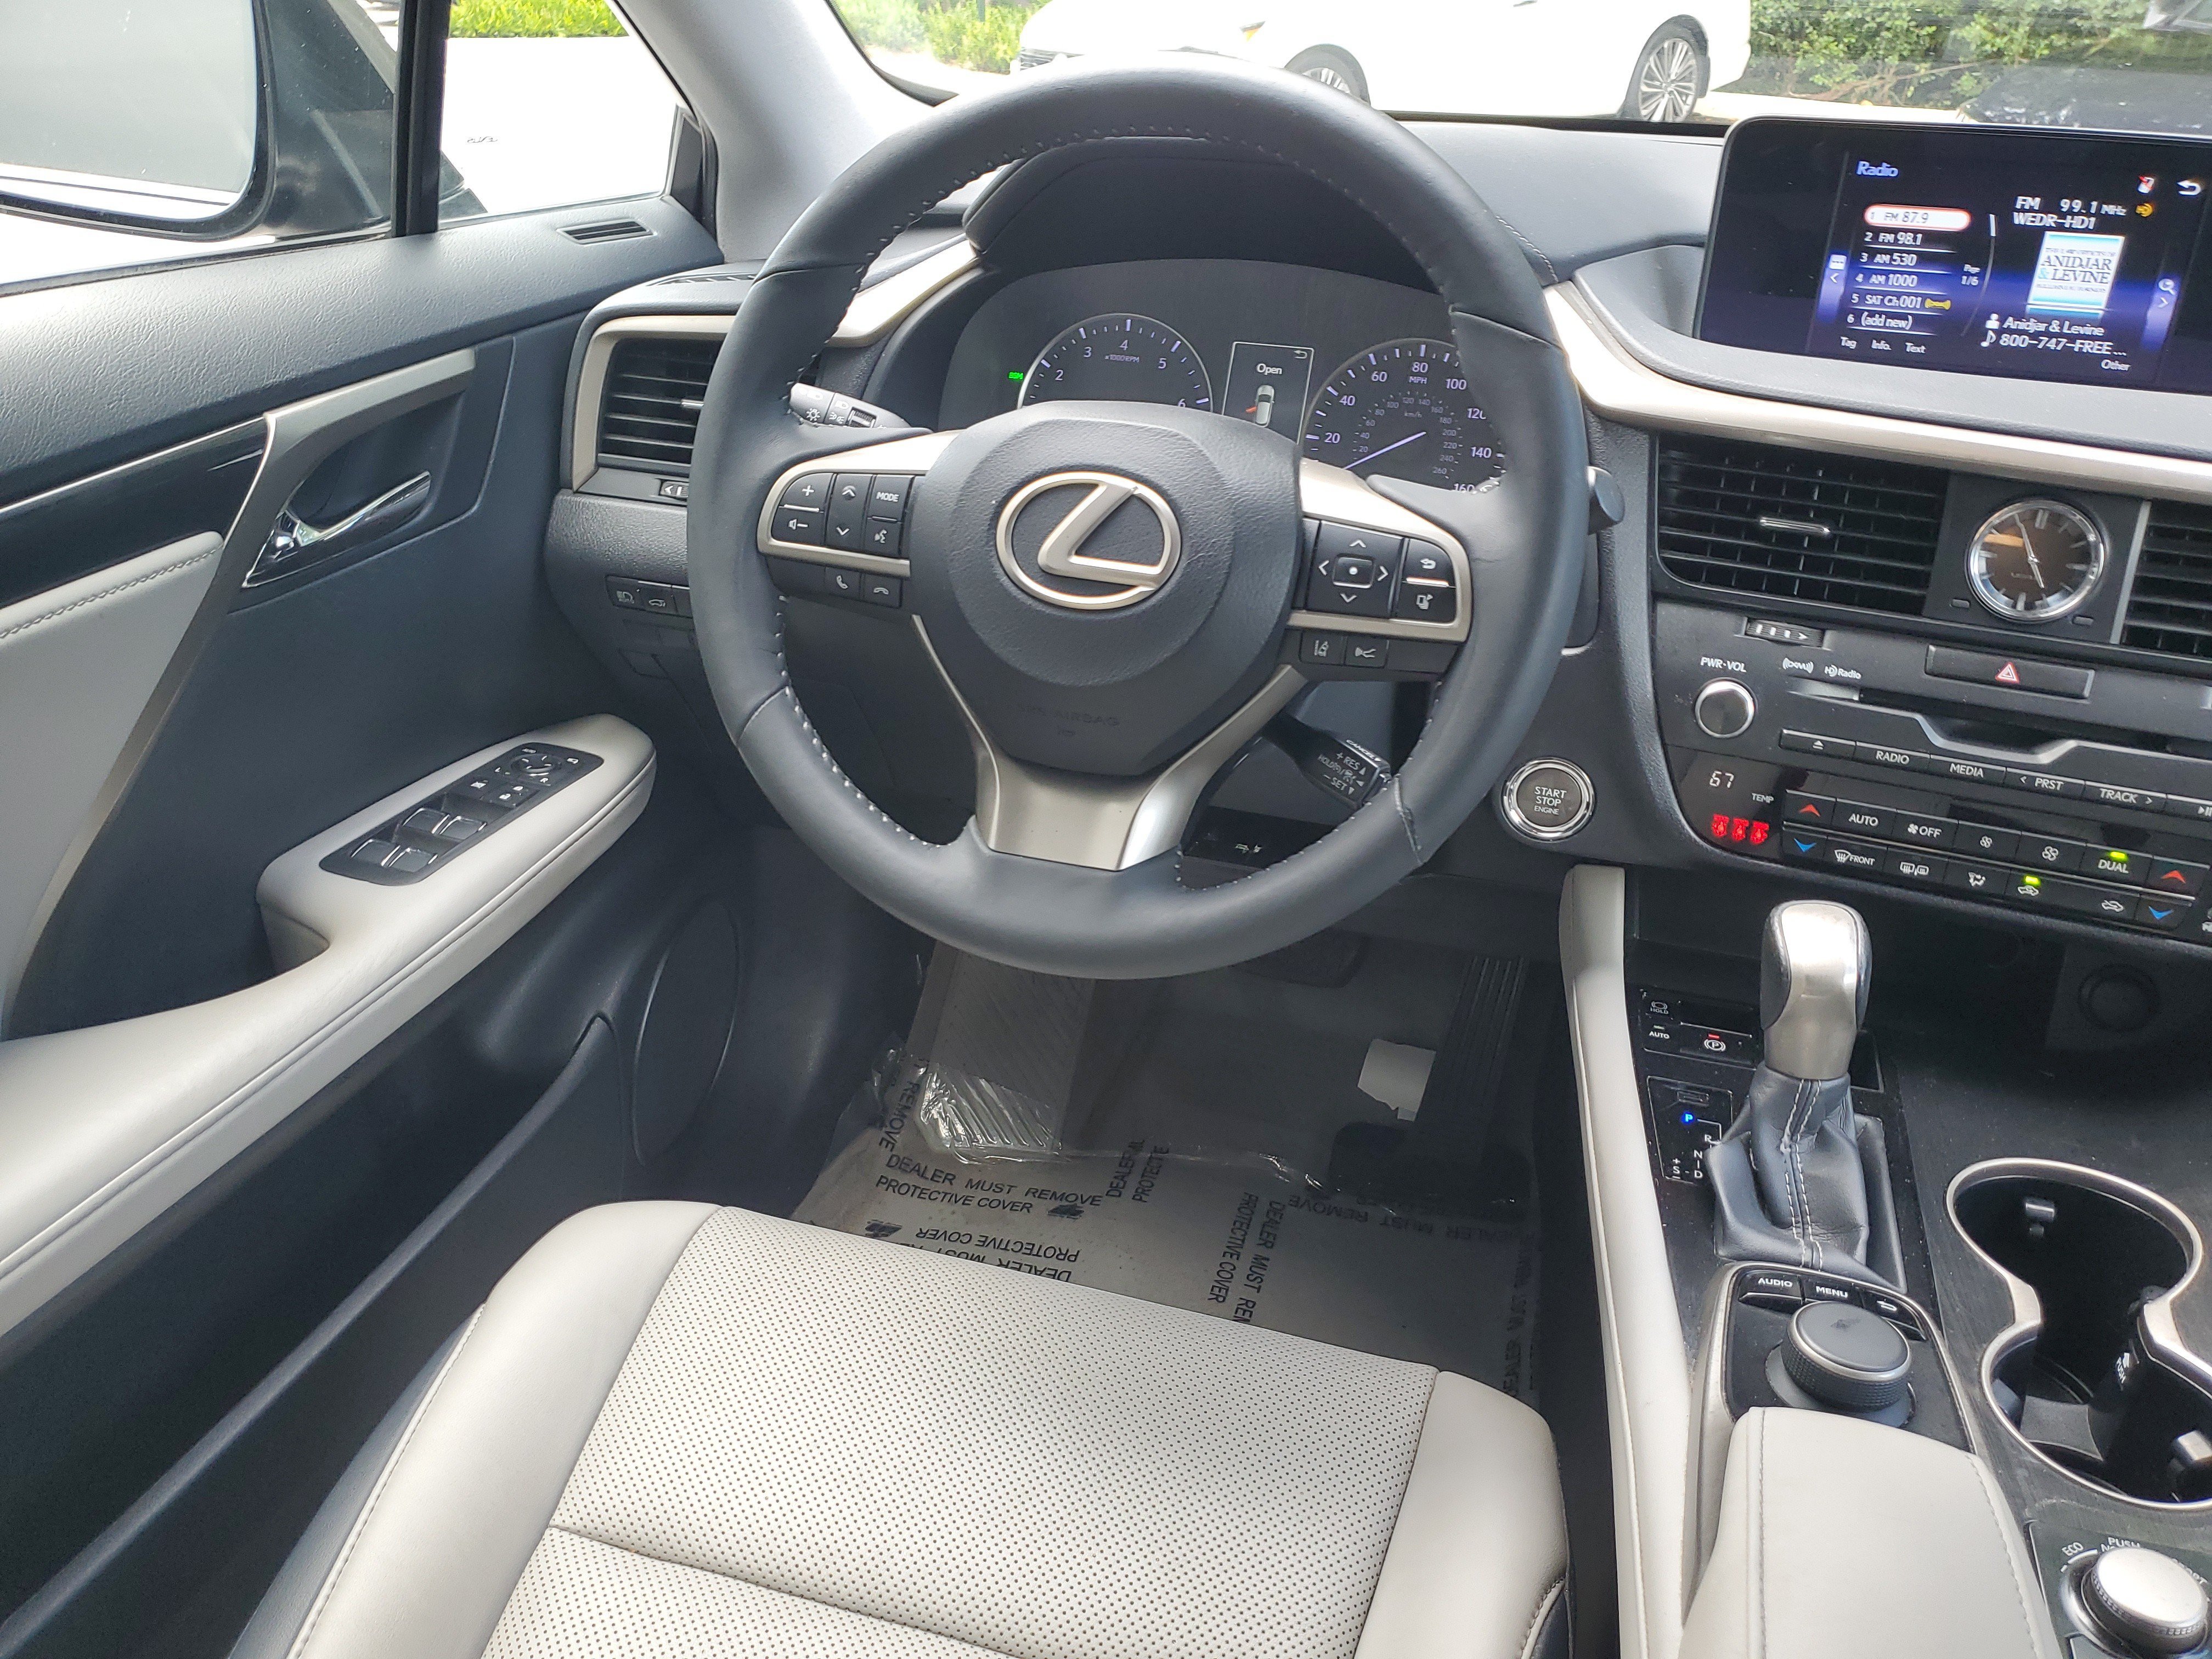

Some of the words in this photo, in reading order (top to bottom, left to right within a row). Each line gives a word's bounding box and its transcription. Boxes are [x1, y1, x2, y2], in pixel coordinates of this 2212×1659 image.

[1856, 160, 1899, 177] Radio
[2015, 196, 2041, 210] FM
[2060, 198, 2098, 214] 99.1
[2100, 204, 2128, 216] MHz
[1884, 212, 1898, 222] FM
[1901, 211, 1929, 223] 87.9
[2012, 212, 2096, 230] WEDR-HD1
[1864, 231, 1873, 241] 2
[1878, 233, 1894, 243] FM
[1897, 232, 1923, 245] 98.1
[1860, 252, 1868, 262] 3
[1874, 253, 1891, 264] AM
[1891, 253, 1917, 266] 530
[2040, 255, 2112, 271] ANIDJAR
[1855, 273, 1864, 283] 4
[1869, 275, 1886, 284] AM
[1888, 274, 1918, 287] 1000
[1961, 275, 1979, 286] 1/6
[2051, 269, 2110, 284] LEVINE
[1851, 294, 1860, 303] 5
[1865, 295, 1883, 304] SAT
[1847, 314, 1855, 323] 6
[1860, 311, 1886, 326] (add
[1885, 315, 1913, 329] new)
[2002, 316, 2048, 334] Anidjar
[2049, 320, 2061, 332] &
[2063, 320, 2104, 336] Levine
[1119, 339, 1129, 351] 4
[1841, 336, 1857, 349] Tag
[1905, 342, 1927, 354] Text
[1083, 346, 1092, 358] 3
[1158, 358, 1167, 369] 5
[1256, 363, 1283, 376] Open
[1412, 362, 1429, 374] 80
[2101, 359, 2131, 371] Other
[1054, 369, 1064, 381] 2
[1371, 370, 1387, 383] 60
[1409, 375, 1427, 385] MPH
[1446, 378, 1467, 390] 100
[1177, 398, 1186, 408] 6
[1339, 394, 1356, 407] 40
[1324, 433, 1340, 444] 20
[1471, 446, 1492, 458] 140
[876, 491, 899, 503] MODE
[1837, 665, 1861, 680] Radio
[1709, 770, 1734, 788] 67
[1875, 750, 1910, 765] RADIO
[1949, 763, 1984, 778] MEDIA
[2034, 777, 2064, 792] PRST
[2099, 788, 2138, 804] TRACK
[1534, 786, 1567, 799] START
[1751, 793, 1774, 804] TEMP
[1535, 795, 1562, 807] STOP
[1534, 805, 1560, 816] ENGINE
[1848, 813, 1879, 827] AUTO
[1918, 826, 1942, 838] OFF
[1849, 853, 1875, 866] FRONT
[2097, 859, 2130, 874] DUAL
[1649, 1030, 1670, 1040] AUTO
[879, 1081, 921, 1152] REMOVE
[1685, 1114, 1694, 1122] P
[1704, 1135, 1712, 1143] R
[1694, 1150, 1703, 1159] N
[885, 1153, 956, 1186] DEALER
[964, 1178, 1018, 1195] MUST
[1024, 1187, 1104, 1207] REMOVE
[875, 1175, 975, 1207] PROTECTIVE
[977, 1197, 1034, 1214] COVER
[1256, 1199, 1286, 1250] DEALER
[915, 1227, 973, 1245] COVER
[974, 1234, 1081, 1263] PROTECTIVE
[1244, 1254, 1271, 1294] MUST
[1207, 1261, 1237, 1305] COVER
[1757, 1277, 1793, 1288] AUDIO
[1815, 1285, 1848, 1299] MENU
[2115, 1356, 2127, 1385] PUSH
[2107, 1536, 2141, 1548] PUSH
[2061, 1542, 2084, 1556] ECO
